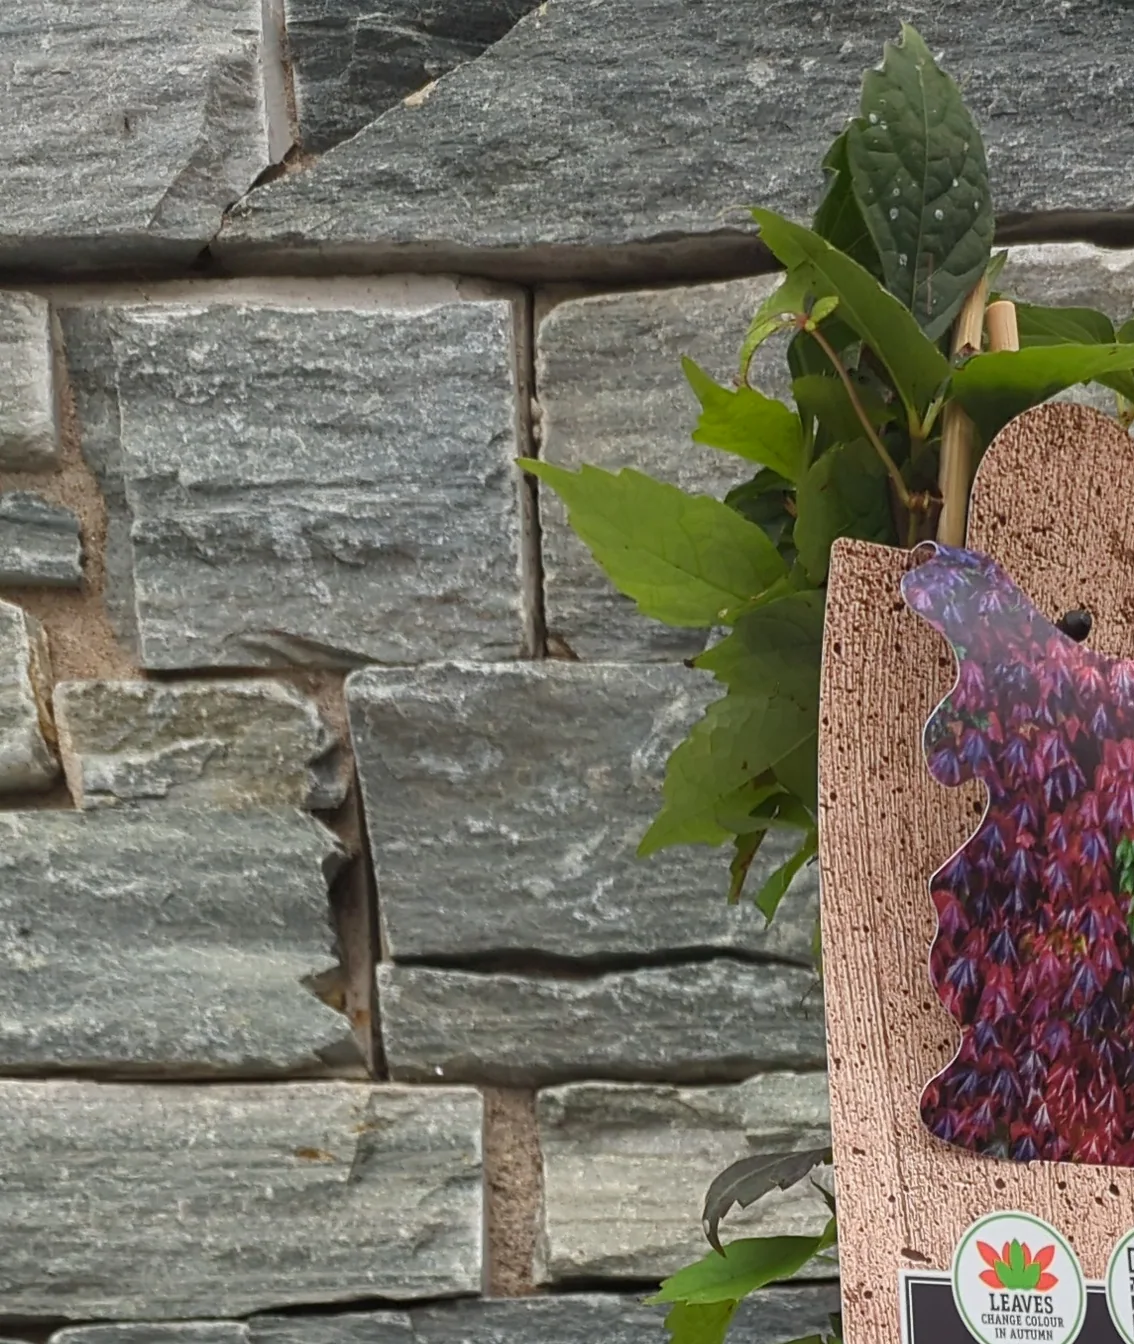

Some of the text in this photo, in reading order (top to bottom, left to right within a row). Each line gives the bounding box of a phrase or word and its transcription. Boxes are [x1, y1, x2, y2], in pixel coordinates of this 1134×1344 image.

[989, 1293, 1054, 1315] LEAVES
[981, 1313, 1065, 1328] CHANGE COLOUR
[995, 1327, 1054, 1342] IN AUTUMN
